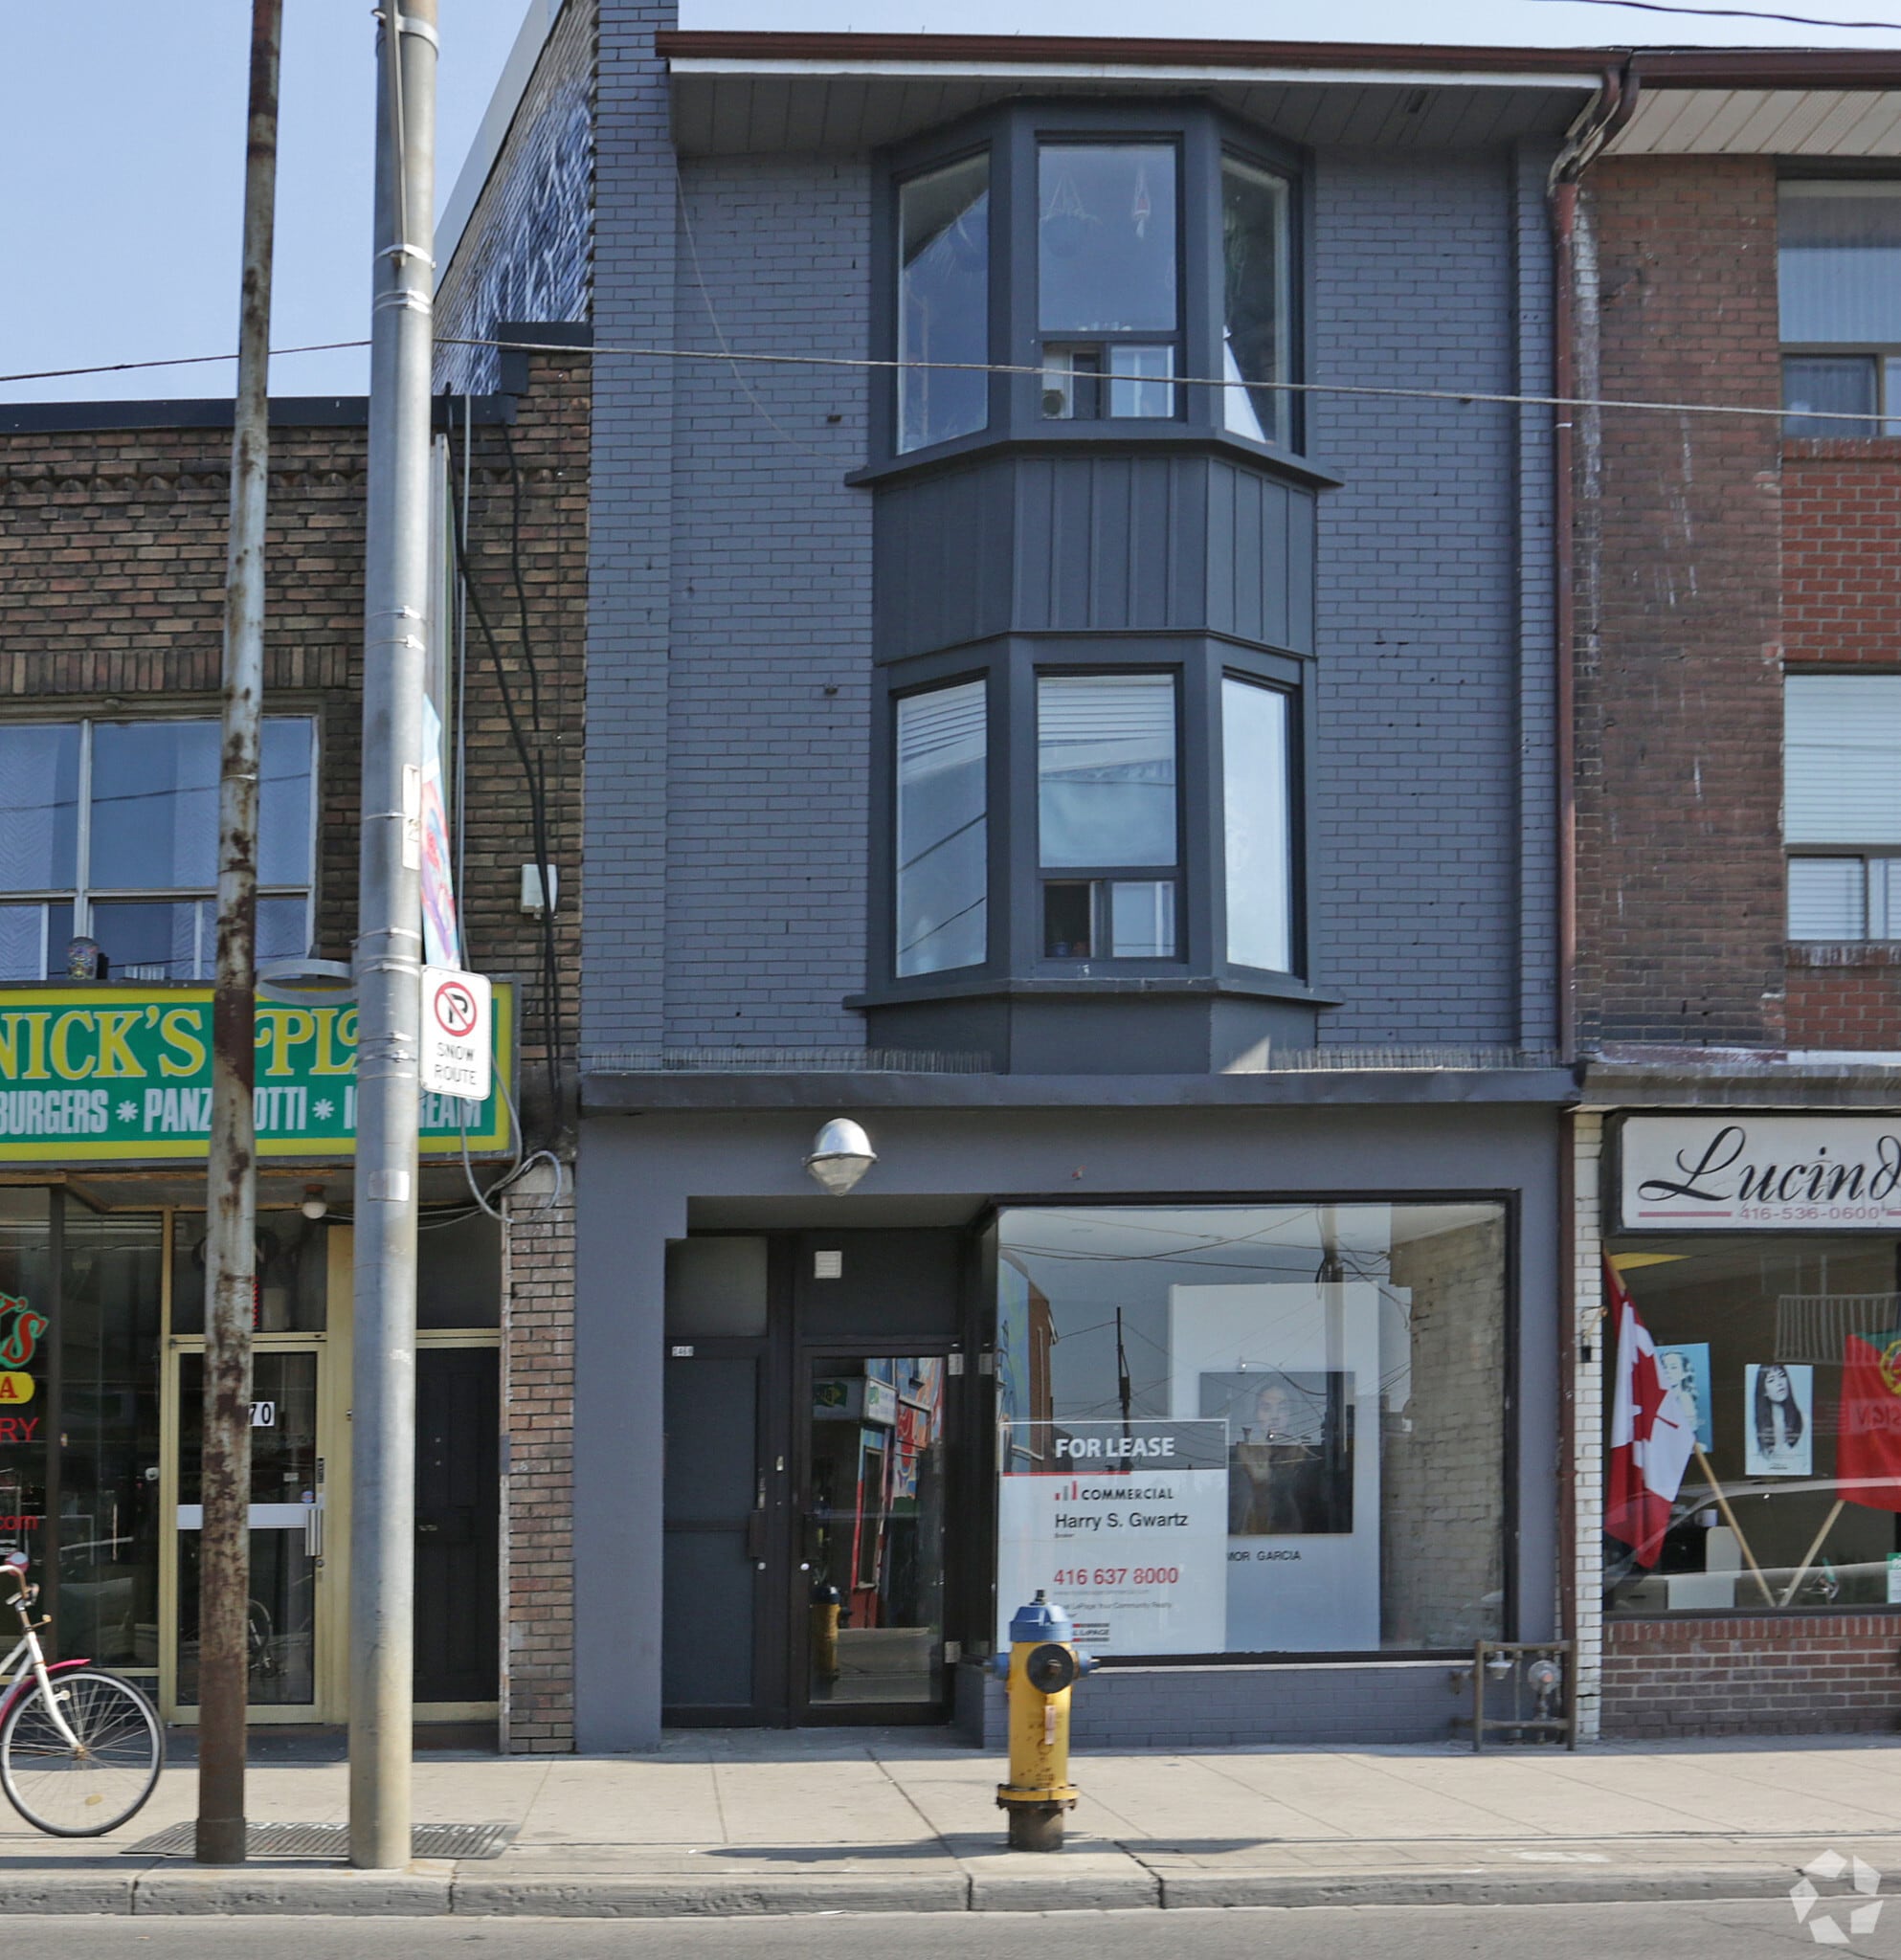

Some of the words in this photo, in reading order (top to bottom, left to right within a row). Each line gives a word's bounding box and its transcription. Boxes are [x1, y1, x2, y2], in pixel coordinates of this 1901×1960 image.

[255, 1008, 358, 1076] PL
[436, 1041, 476, 1061] SNOW
[434, 1063, 478, 1085] ROUTE
[145, 1086, 307, 1132] PANZOTTI
[1740, 1206, 1879, 1220] 416-536-0600
[1055, 1437, 1101, 1459] FOR
[1106, 1437, 1175, 1458] LEASE
[1081, 1487, 1174, 1501] COMMERCIAL
[1055, 1513, 1102, 1531] Harry
[1107, 1512, 1123, 1528] S.
[1129, 1512, 1189, 1528] Gwartz
[1256, 1550, 1302, 1561] GARCIA
[1054, 1568, 1088, 1586] 416
[1093, 1567, 1127, 1585] 637
[1133, 1566, 1179, 1584] 8000
